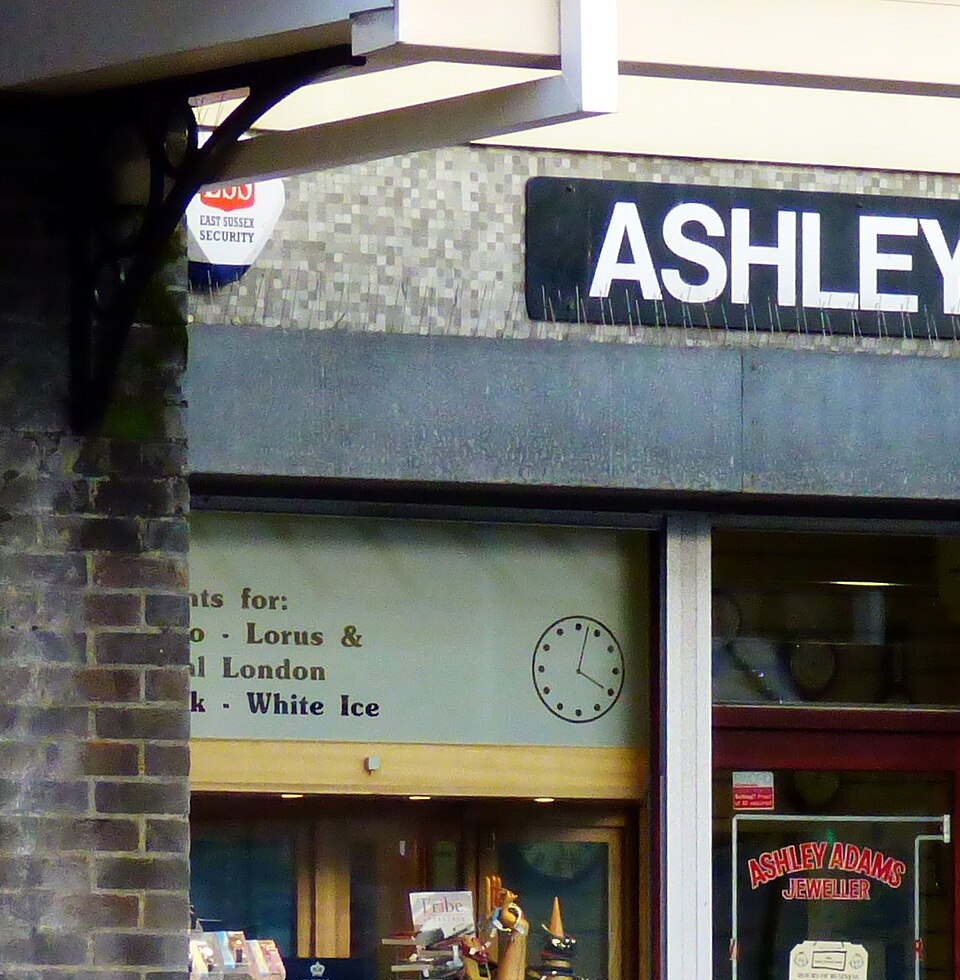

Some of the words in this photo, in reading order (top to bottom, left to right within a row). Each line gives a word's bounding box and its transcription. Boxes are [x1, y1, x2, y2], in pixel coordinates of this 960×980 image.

[199, 215, 221, 226] EAST
[223, 217, 255, 229] SUSSEX
[199, 230, 255, 243] SECURITY
[241, 587, 288, 611] for:
[246, 622, 324, 646] Lorus
[341, 625, 362, 648] &
[222, 656, 326, 681] London
[246, 691, 324, 716] White
[340, 694, 380, 718] Ice
[748, 842, 828, 890] ASHLEY
[828, 842, 906, 888] ADAMS
[782, 878, 871, 900] JEWELLER
